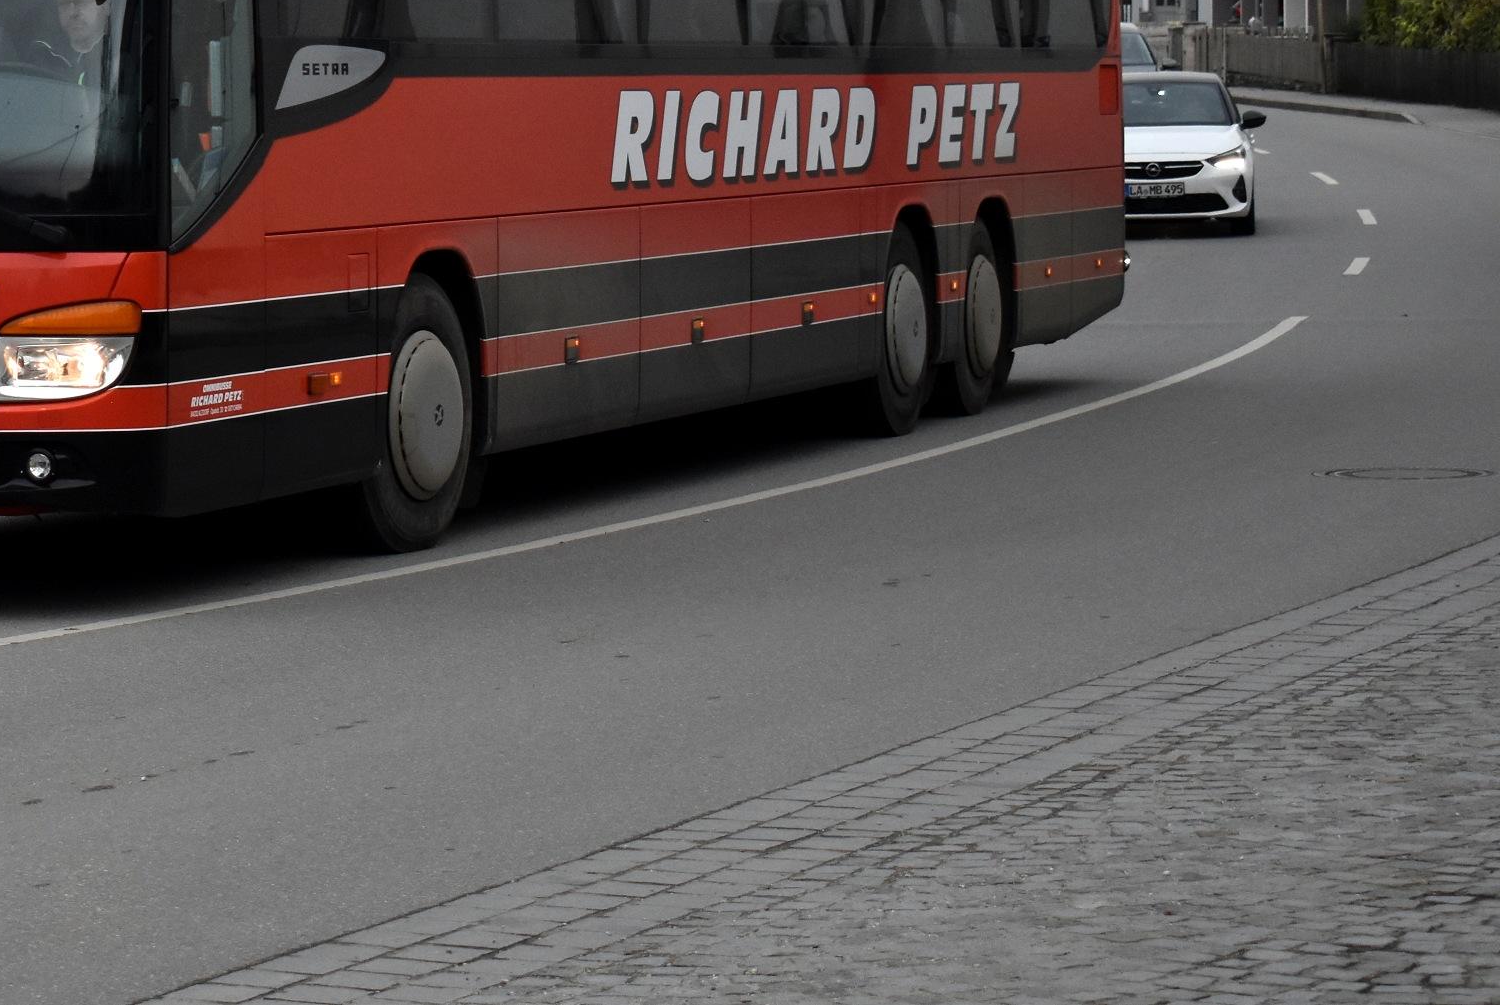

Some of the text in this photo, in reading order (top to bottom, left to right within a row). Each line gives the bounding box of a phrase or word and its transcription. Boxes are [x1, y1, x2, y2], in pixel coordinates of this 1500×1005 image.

[302, 63, 349, 76] SETRA
[610, 82, 1020, 187] RICHARD PETZ
[190, 390, 242, 408] RICHARD PETZ
